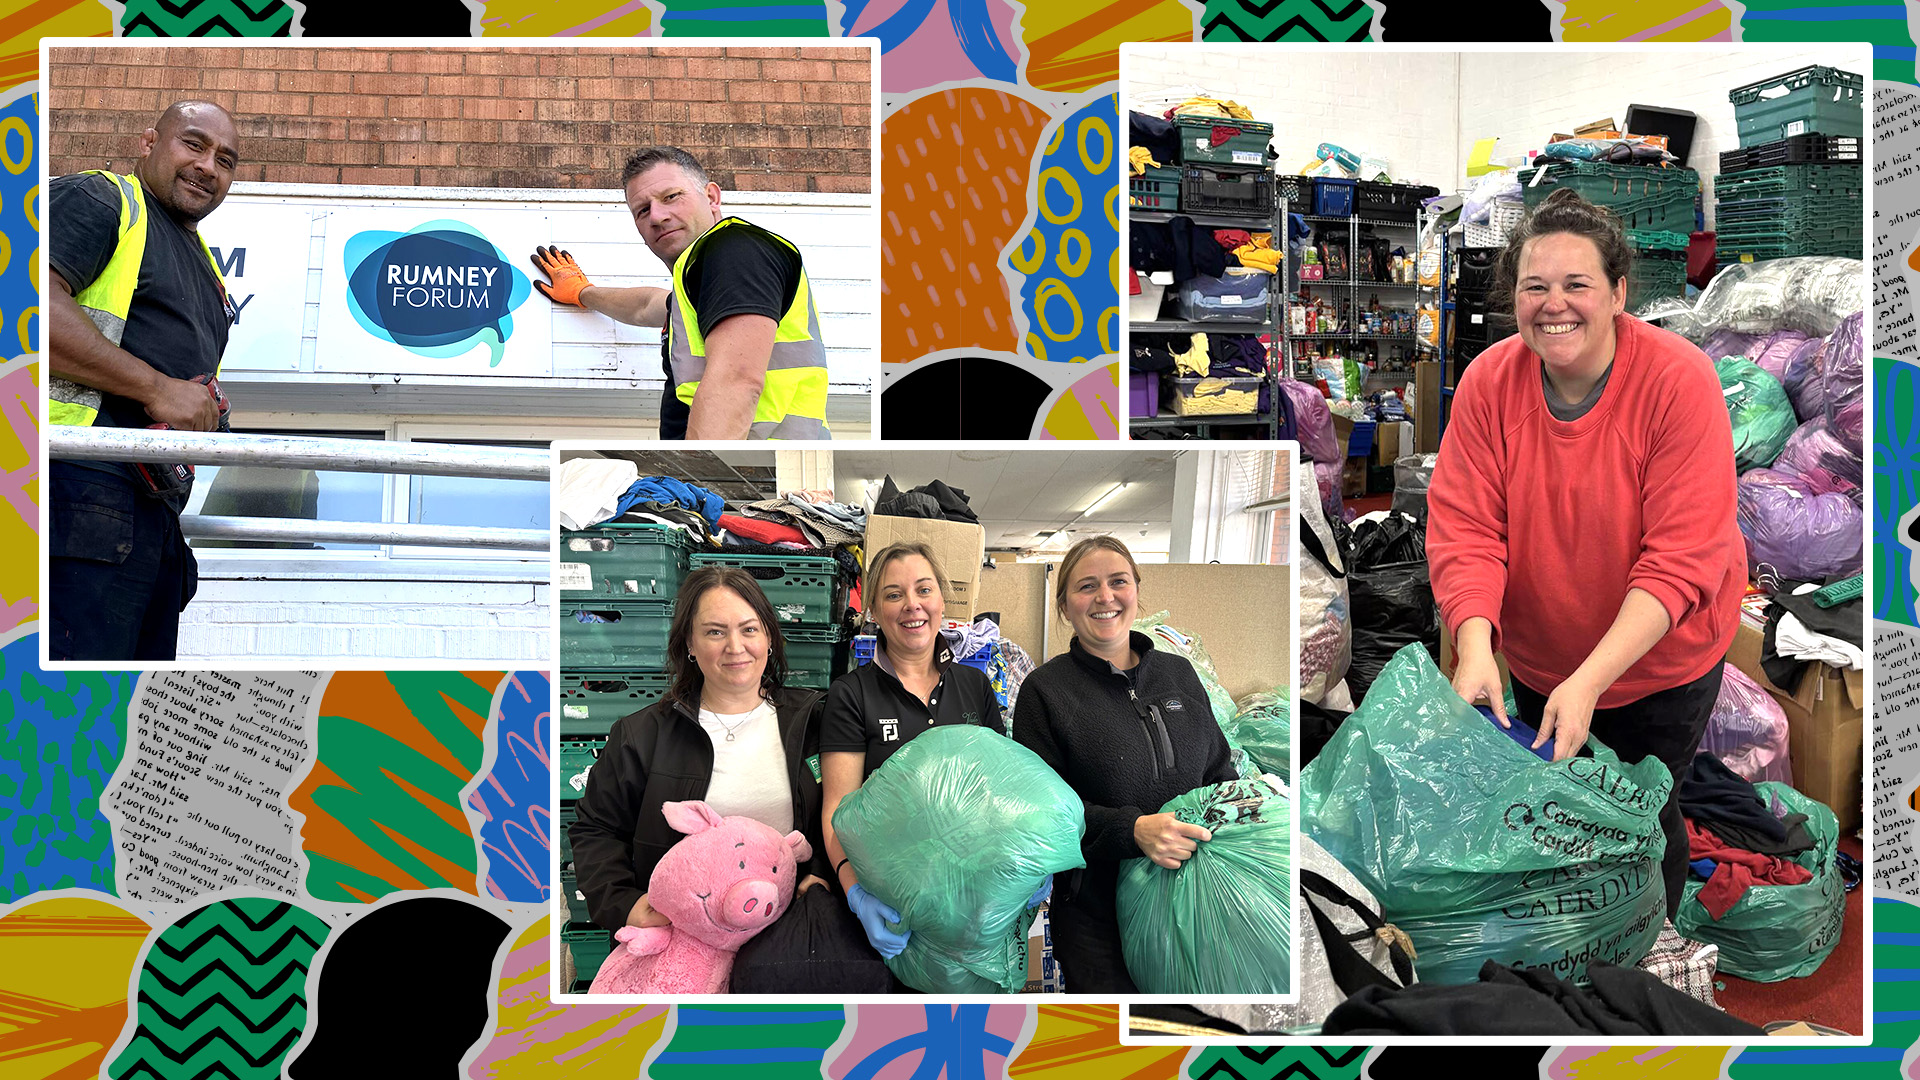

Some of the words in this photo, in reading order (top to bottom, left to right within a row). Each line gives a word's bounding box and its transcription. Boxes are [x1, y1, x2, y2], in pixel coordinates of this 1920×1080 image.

[387, 264, 498, 287] RUMNEY
[392, 286, 489, 309] FORUM
[883, 724, 899, 742] FJ
